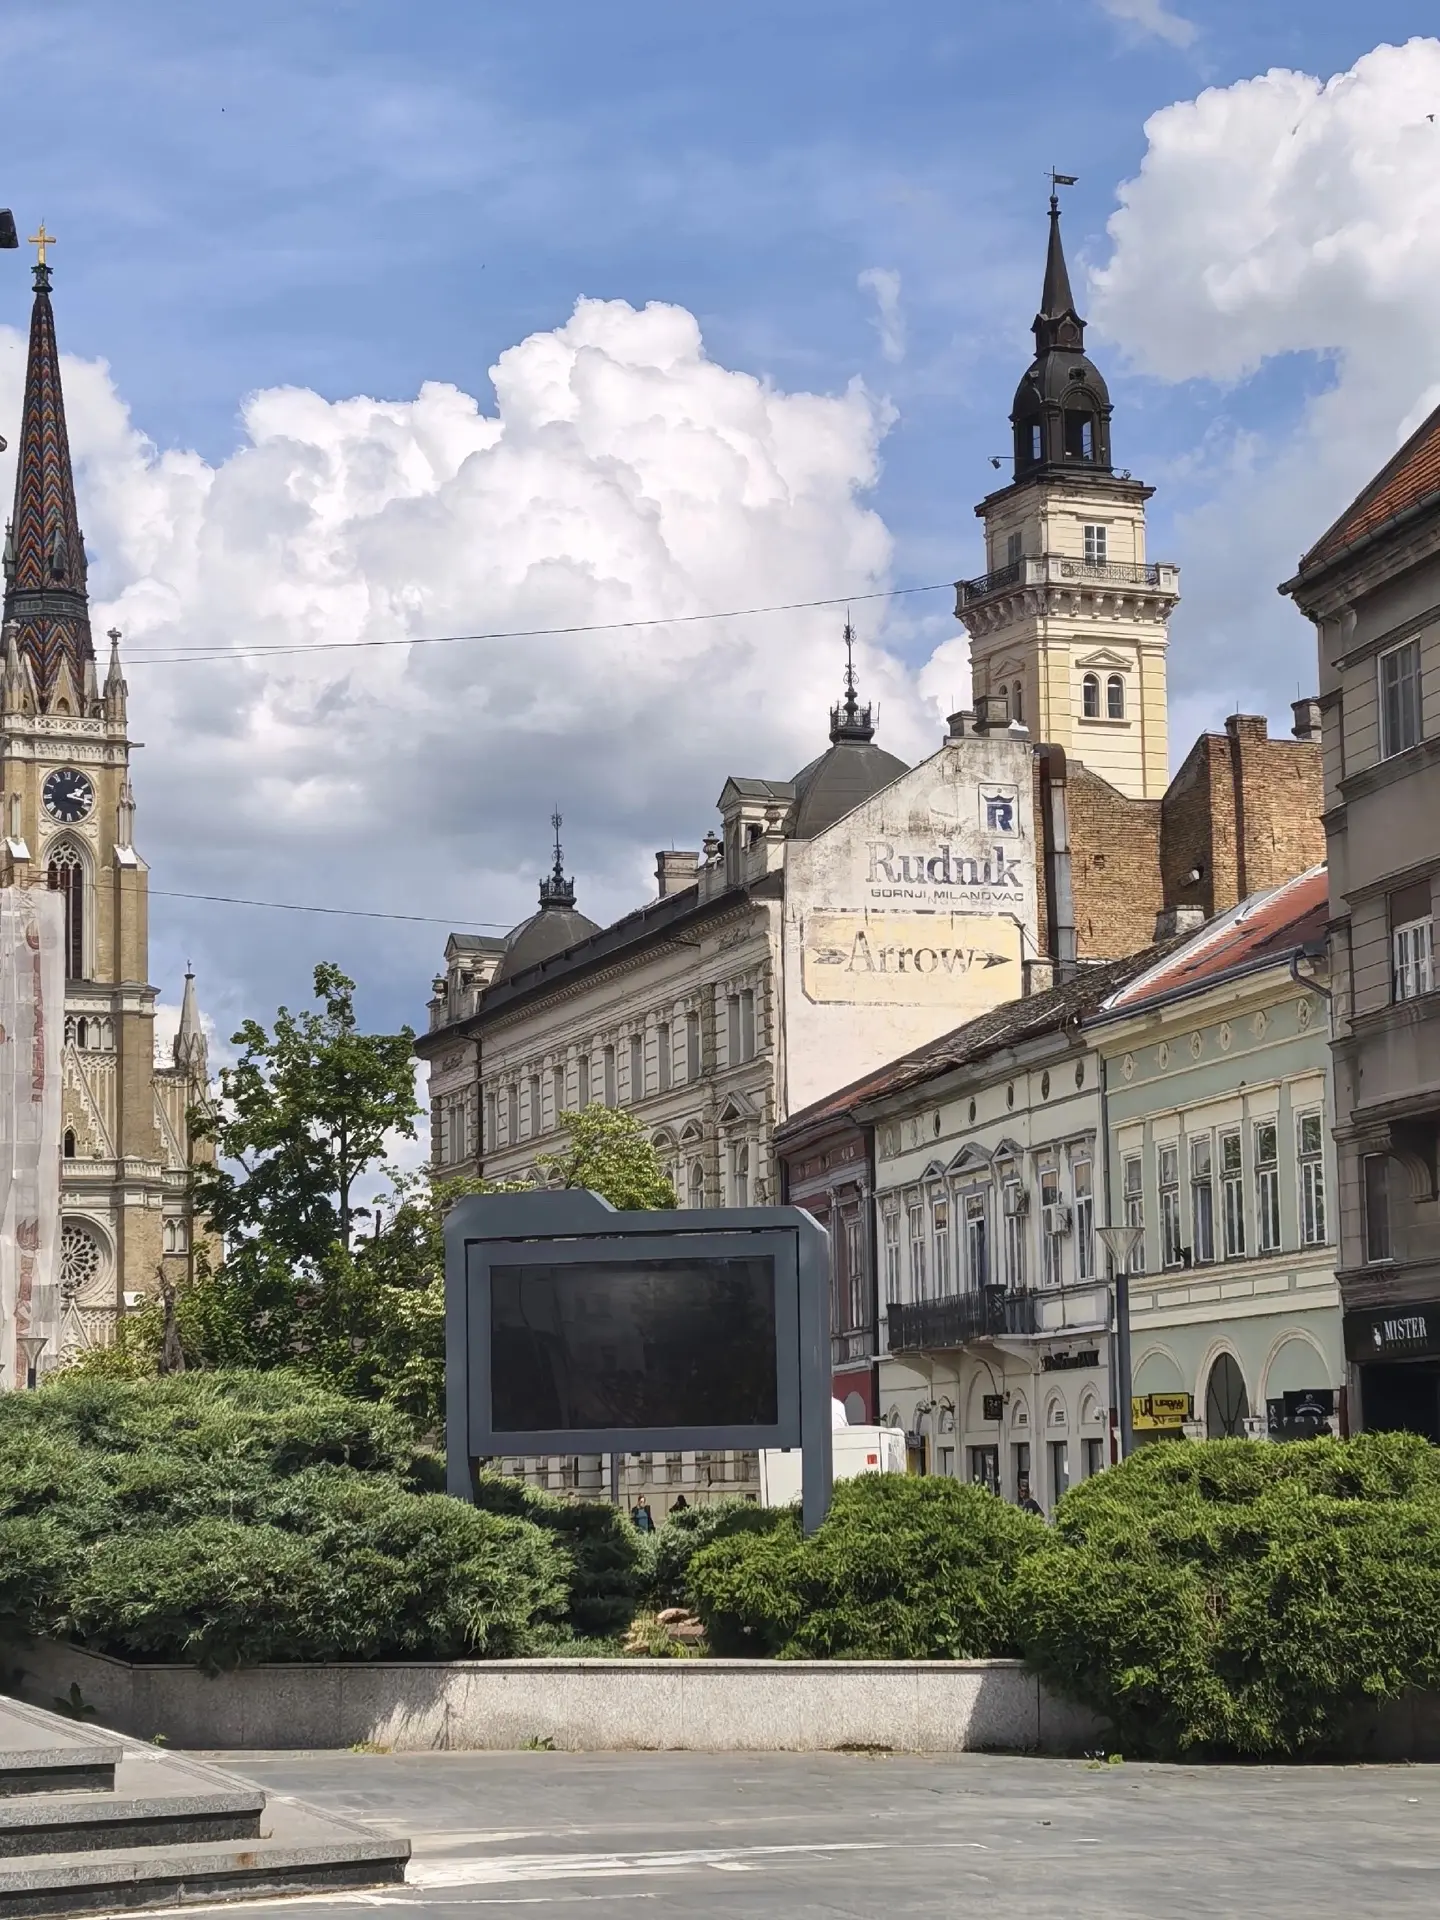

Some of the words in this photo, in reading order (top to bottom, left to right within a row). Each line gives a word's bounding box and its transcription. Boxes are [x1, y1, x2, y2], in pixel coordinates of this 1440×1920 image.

[865, 841, 1024, 888] Rudnik
[871, 888, 927, 899] GORNJI
[933, 890, 1024, 902] MILANOVAC
[845, 930, 976, 974] Arrow
[1383, 1316, 1428, 1341] MISTER
